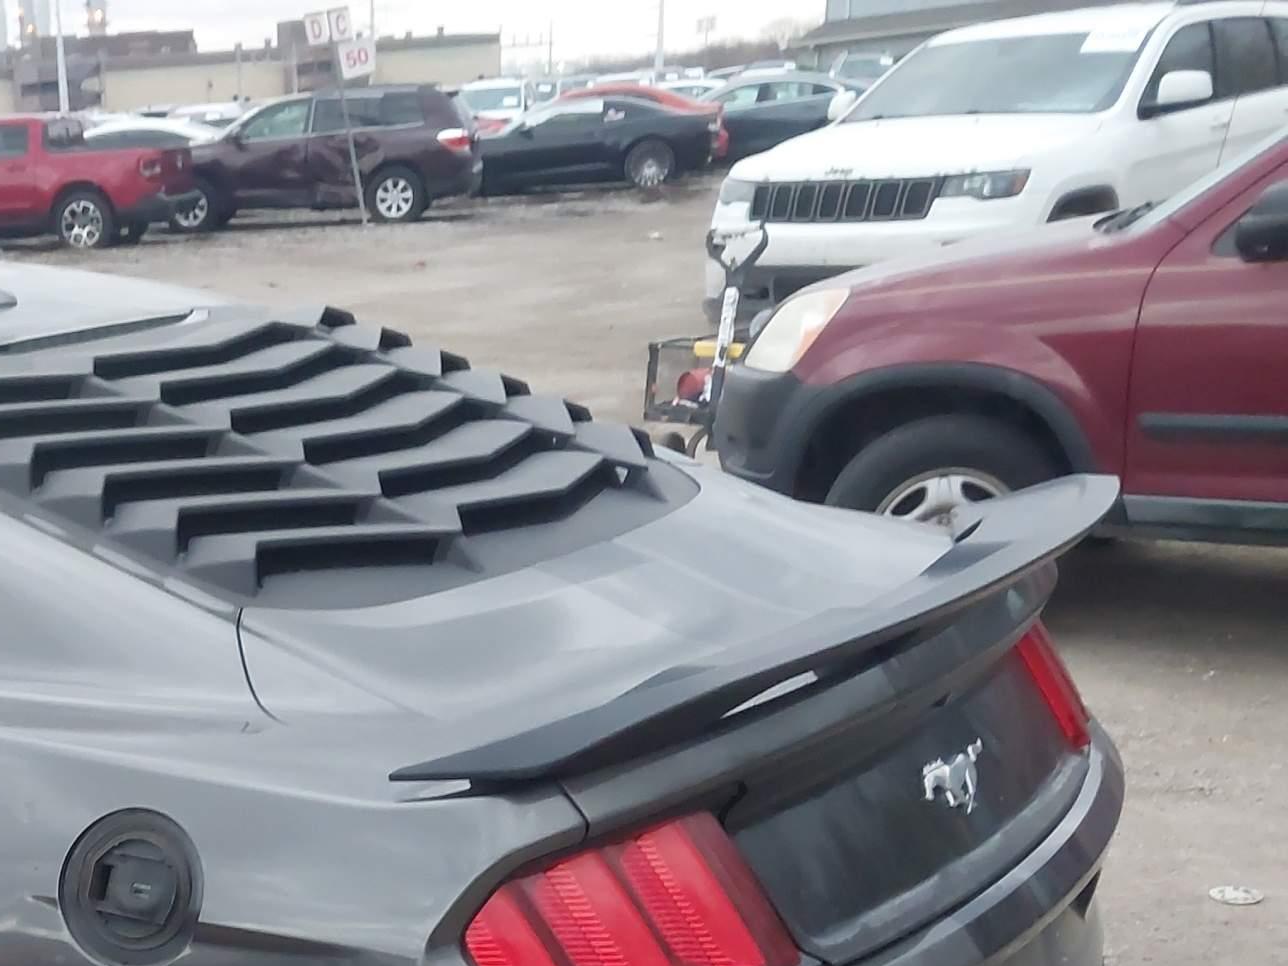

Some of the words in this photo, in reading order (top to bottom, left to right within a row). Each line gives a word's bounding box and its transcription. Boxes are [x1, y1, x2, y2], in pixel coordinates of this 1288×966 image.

[310, 18, 322, 40] D
[336, 13, 347, 36] C
[345, 47, 369, 69] 50
